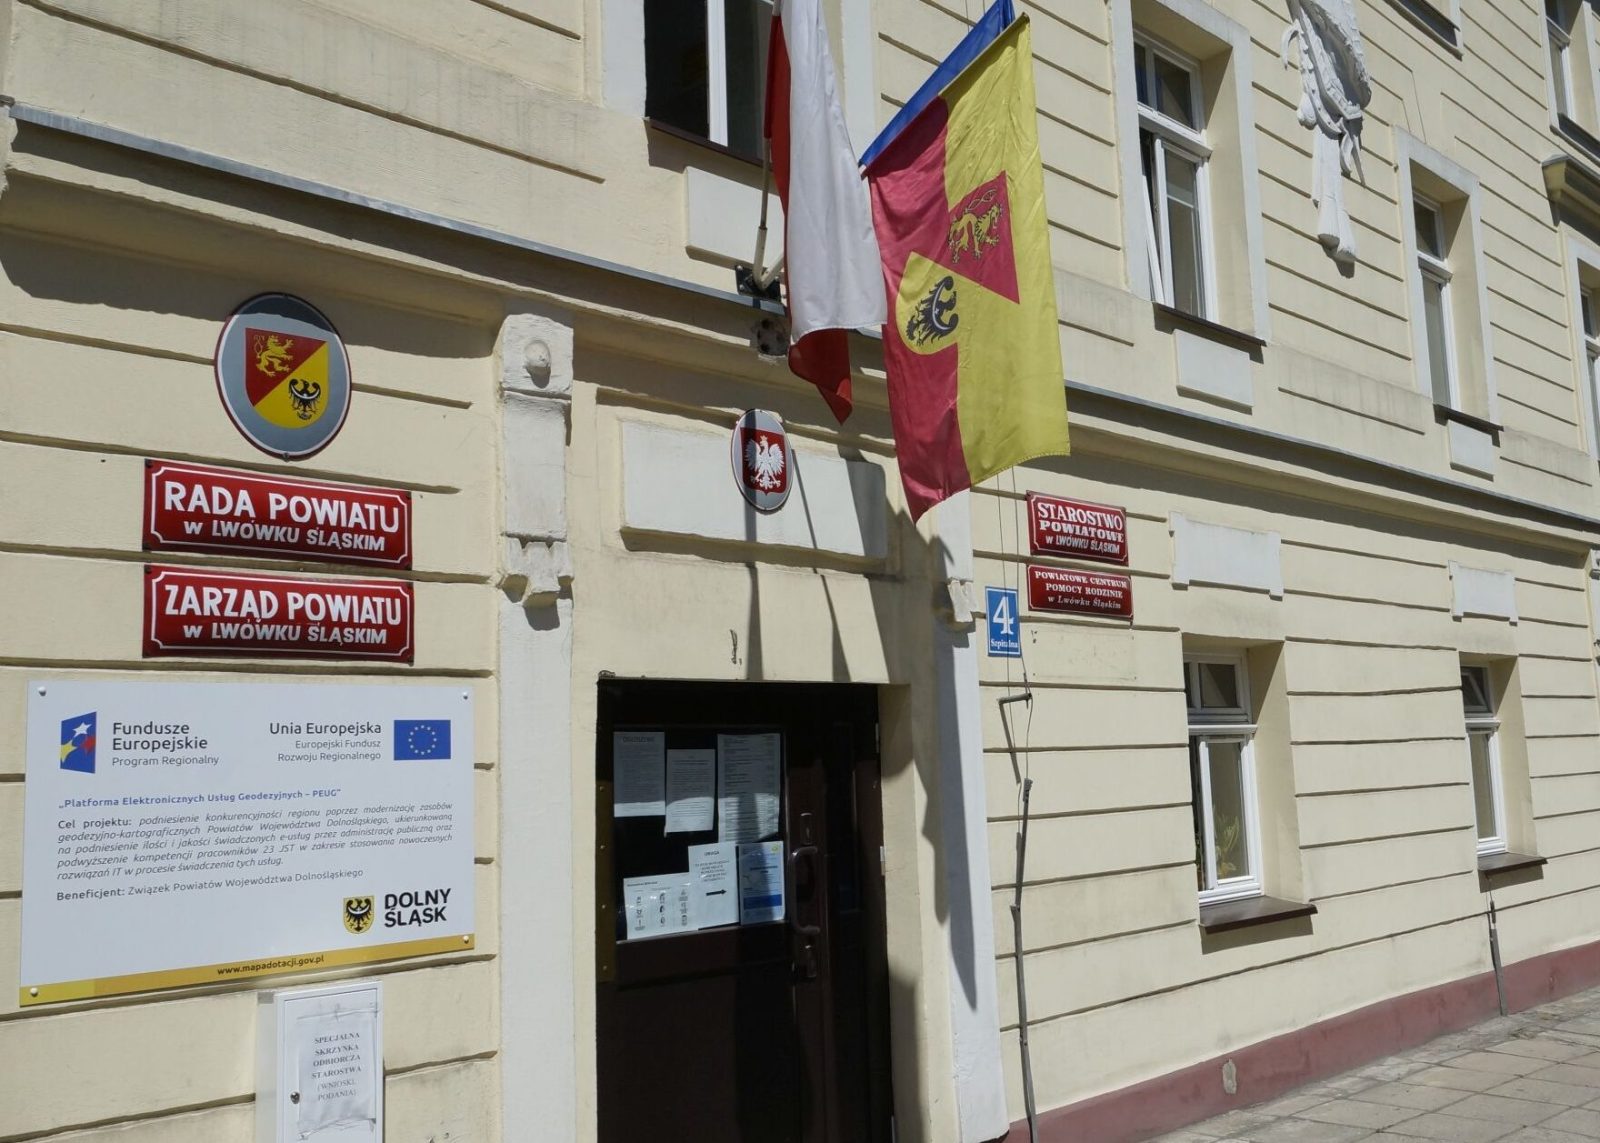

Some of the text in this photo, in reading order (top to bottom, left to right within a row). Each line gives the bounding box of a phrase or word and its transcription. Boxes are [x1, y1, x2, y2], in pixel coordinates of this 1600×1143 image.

[164, 480, 399, 533] RADA POWIATU
[1037, 502, 1123, 531] STAROSTWO
[184, 519, 385, 551] w LWÓWKU ŚLĄSKIM
[1039, 520, 1124, 543] POWIATOWE
[1045, 534, 1120, 554] w LWÓWKU ŚLĄSKIM
[1034, 570, 1127, 588] POWIATOWE CENTRUM
[1045, 582, 1123, 599] POMOCY RODZINIE
[164, 584, 401, 626] ZARZĄD POWIATU
[1057, 595, 1090, 607] Lwówku
[1092, 596, 1121, 609] Śląskim
[992, 596, 1014, 635] 4
[183, 619, 387, 646] w LWÓWKU ŚLĄSKIM
[113, 721, 190, 735] Fundusze
[269, 722, 382, 736] Unia Europejska
[112, 736, 208, 752] Europejskie
[295, 739, 381, 750] Europejski Fundusz
[112, 755, 219, 768] Program Regionalny
[278, 752, 381, 762] Rozwoju Regionalnego
[122, 794, 204, 806] Elektronicznych
[207, 793, 235, 803] Usług
[238, 790, 302, 801] Geodezyjnych
[58, 802, 452, 830] Cel projektu: podniesienie konkurencyjności regionu poprzez modernizację zasobów
[58, 813, 452, 843] geodezyjno-kartograficznych Powiatów Województwa Dolnośląskiego, ukierunkowaną
[75, 842, 139, 854] podniesienie
[142, 839, 167, 849] ilości
[177, 837, 210, 849] jakości
[214, 833, 276, 844] świadczonych
[280, 832, 311, 841] e-usług
[314, 830, 337, 840] przez
[340, 827, 394, 837] administrację
[397, 824, 433, 834] publiczną
[57, 855, 128, 868] podwyższenie
[133, 851, 192, 862] kompetencji
[197, 848, 258, 859] pracowników
[263, 845, 274, 853] 23
[278, 844, 295, 853] JST
[311, 841, 346, 850] zakresie
[350, 838, 395, 848] stosowania
[398, 834, 452, 844] nowoczesnych
[57, 868, 110, 880] rozwiązań
[112, 867, 122, 876] IT
[135, 864, 176, 875] procesie
[177, 860, 234, 872] świadczenia
[236, 858, 255, 869] tych
[257, 856, 284, 866] usług.
[57, 869, 364, 901] Beneficjent: Związek Powiatów Województwa Dolnośląskiego
[384, 888, 451, 910] DOLNY
[384, 905, 447, 928] ŚLĄSK
[217, 954, 325, 975] www.mapadotacji.gov.pl
[314, 1032, 360, 1044] SPECJALNA
[312, 1054, 361, 1067] ODBIORCZA
[314, 1044, 359, 1056] SKRZYNKA
[311, 1066, 362, 1079] STAROSTWA
